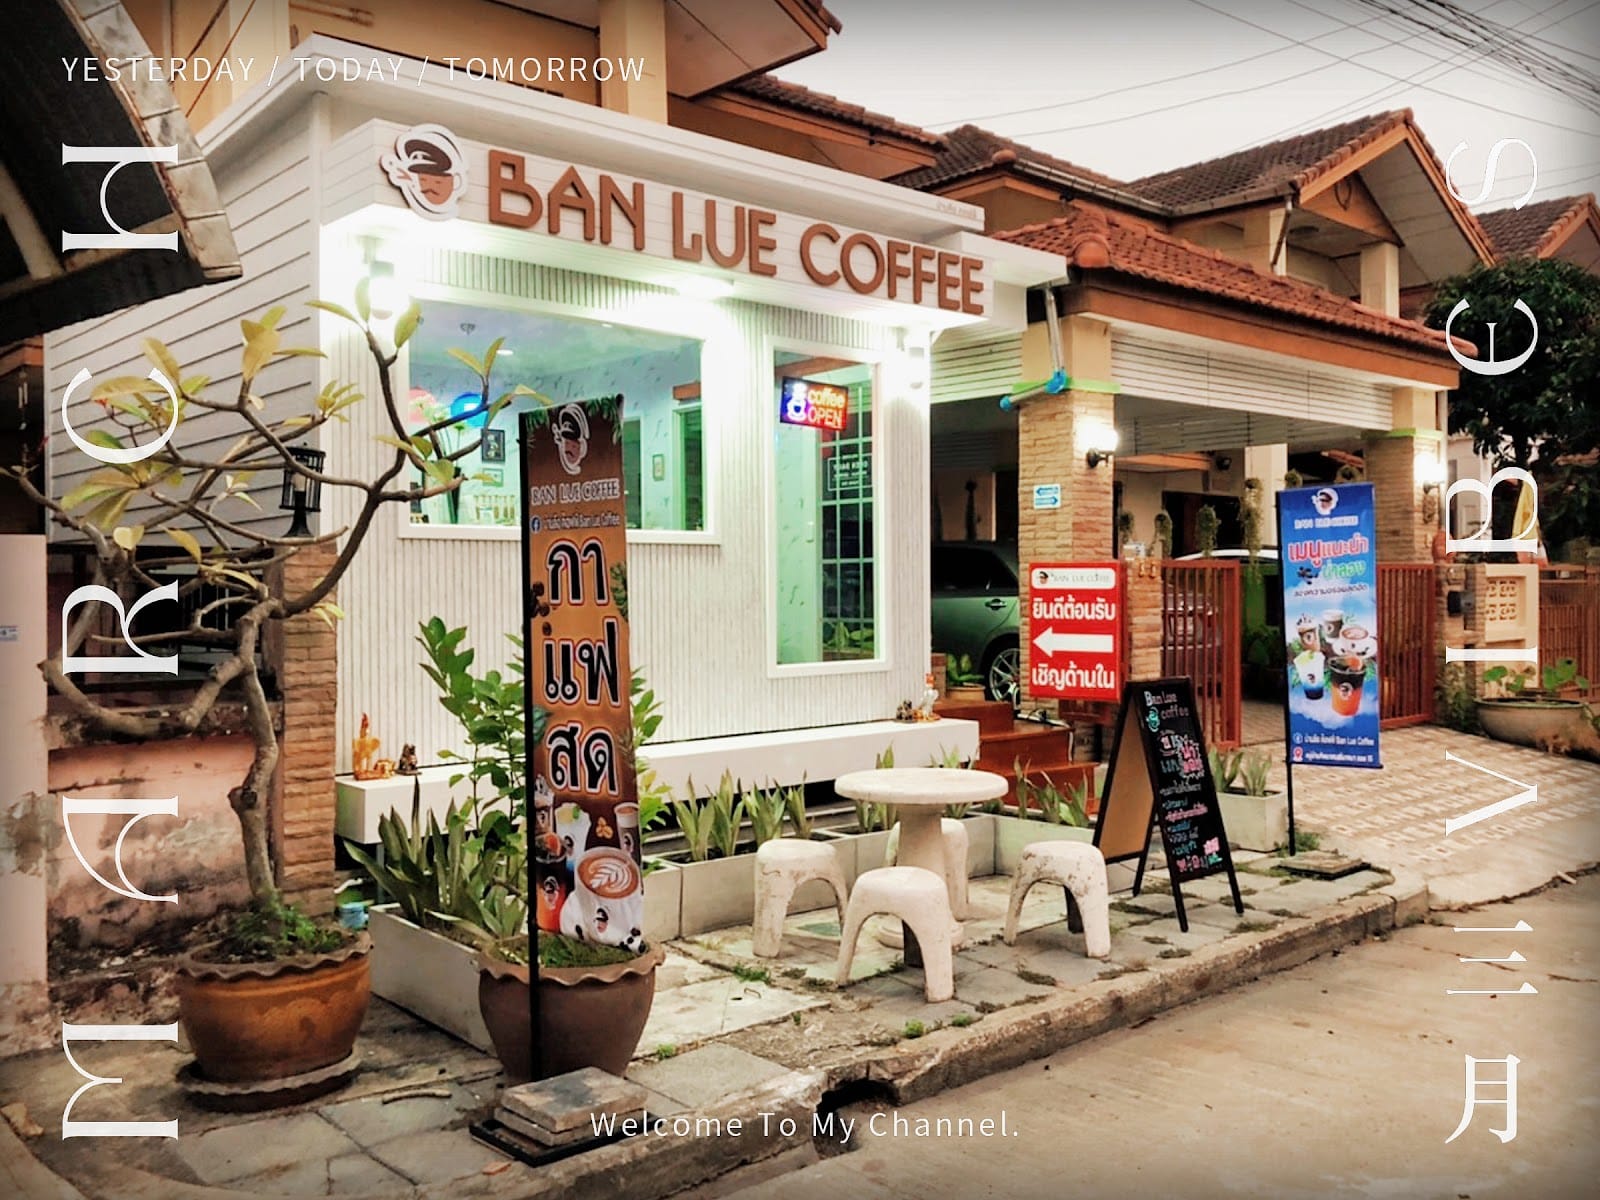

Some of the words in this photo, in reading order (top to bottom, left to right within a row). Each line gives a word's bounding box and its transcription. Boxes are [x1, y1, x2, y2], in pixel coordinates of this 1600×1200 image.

[488, 149, 645, 251] BAN
[672, 192, 777, 276] LUE
[800, 223, 984, 315] COFFEE
[808, 387, 845, 408] coffee
[807, 405, 842, 429] OPEN
[531, 484, 557, 505] BAN
[560, 482, 581, 502] LUE
[581, 478, 620, 501] COFFEE
[547, 538, 608, 606] กา
[1032, 594, 1116, 620] ยินดีต้อนรับ
[543, 617, 621, 707] แฟ
[1032, 661, 1115, 690] เชิญด้านใน
[547, 721, 619, 796] สด
